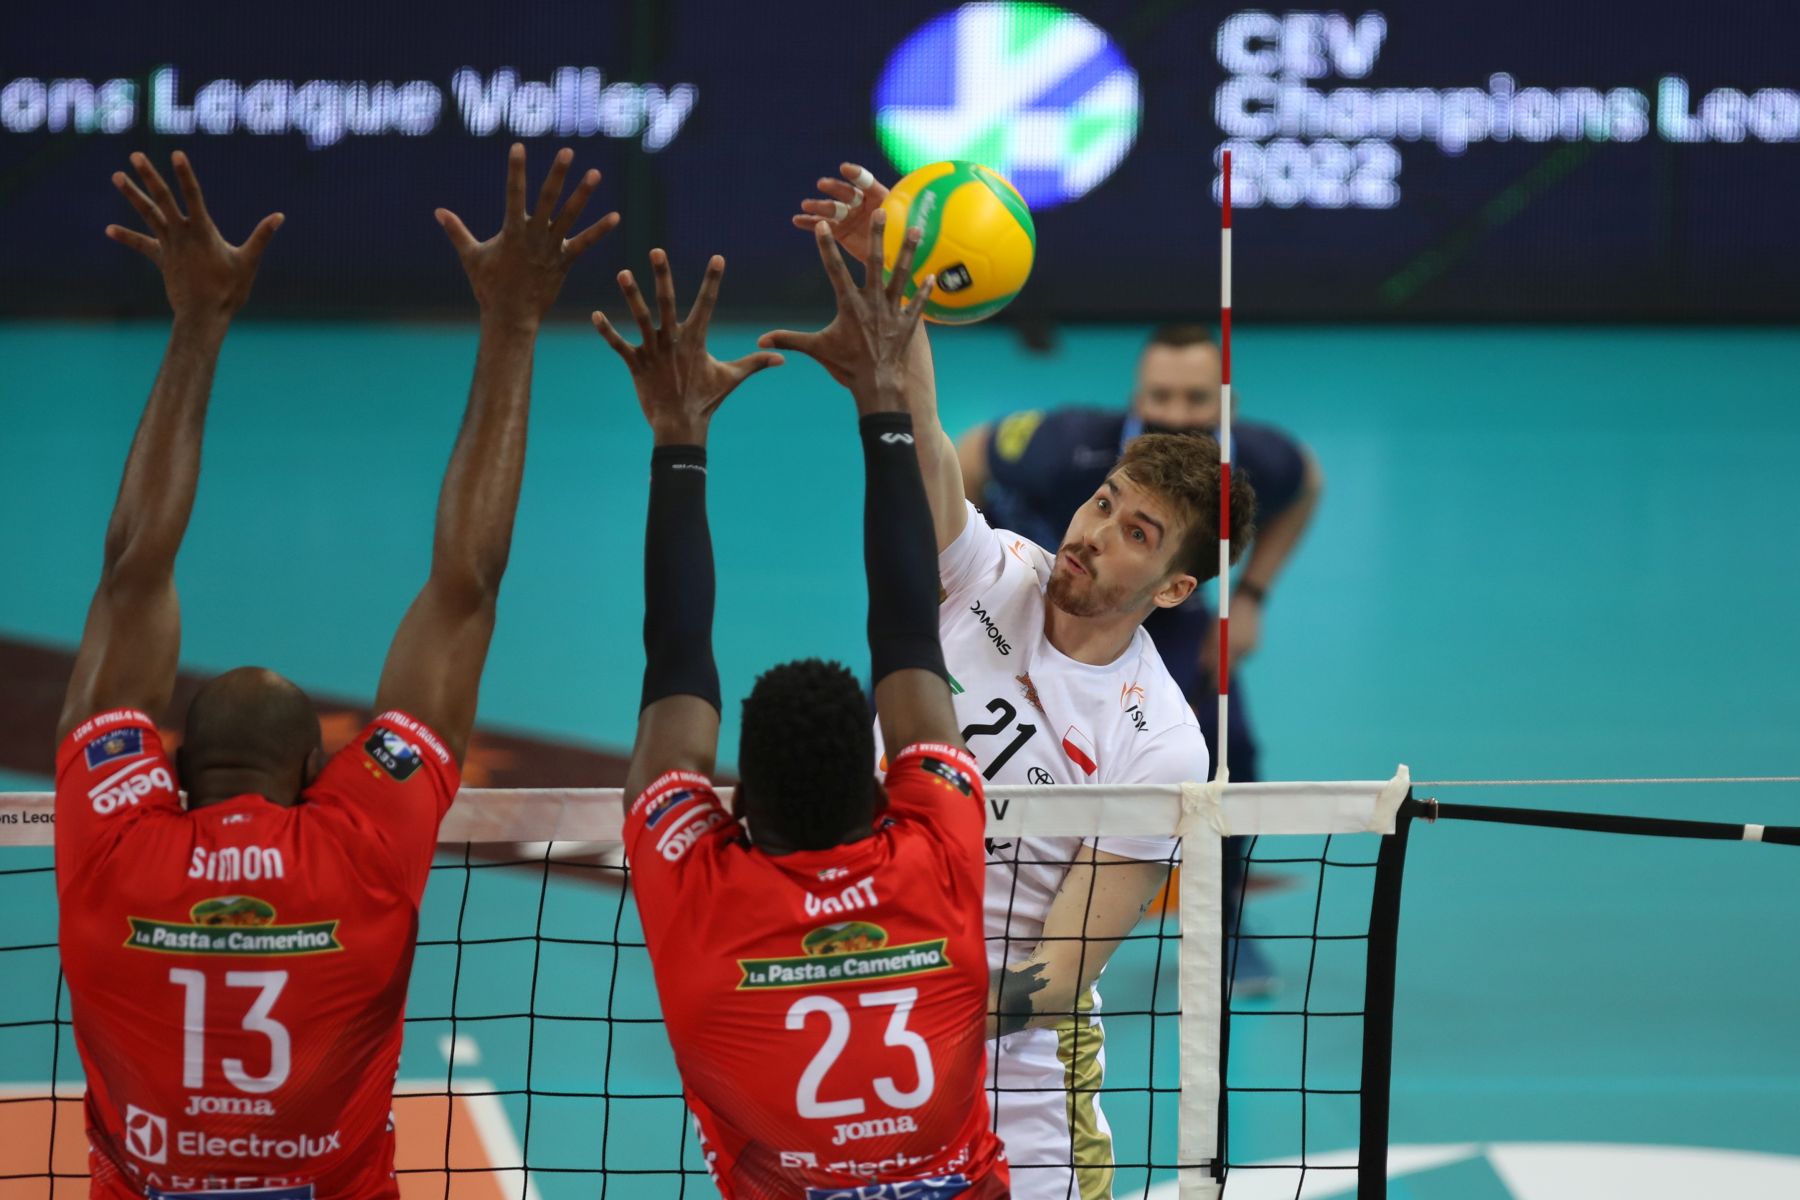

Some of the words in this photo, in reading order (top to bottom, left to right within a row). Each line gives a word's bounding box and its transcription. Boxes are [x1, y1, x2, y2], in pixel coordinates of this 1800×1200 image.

[1215, 11, 1387, 78] CEV
[0, 77, 139, 134] ons
[150, 65, 442, 150] League
[451, 65, 698, 153] Volley
[1214, 72, 1648, 156] Champions
[1213, 137, 1401, 208] 2022
[961, 697, 1037, 782] 21
[0, 814, 18, 824] ns
[92, 766, 174, 815] beko
[188, 846, 284, 882] SIMON
[136, 932, 149, 945] La
[152, 928, 210, 950] Pasta
[212, 936, 227, 950] di
[229, 932, 329, 952] Camerino
[749, 972, 766, 984] La
[768, 963, 825, 983] Pasta
[828, 966, 842, 978] di
[843, 951, 940, 977] Camerino
[169, 967, 291, 1094] 13
[785, 987, 935, 1119] 23
[177, 1130, 341, 1159] Electrolux
